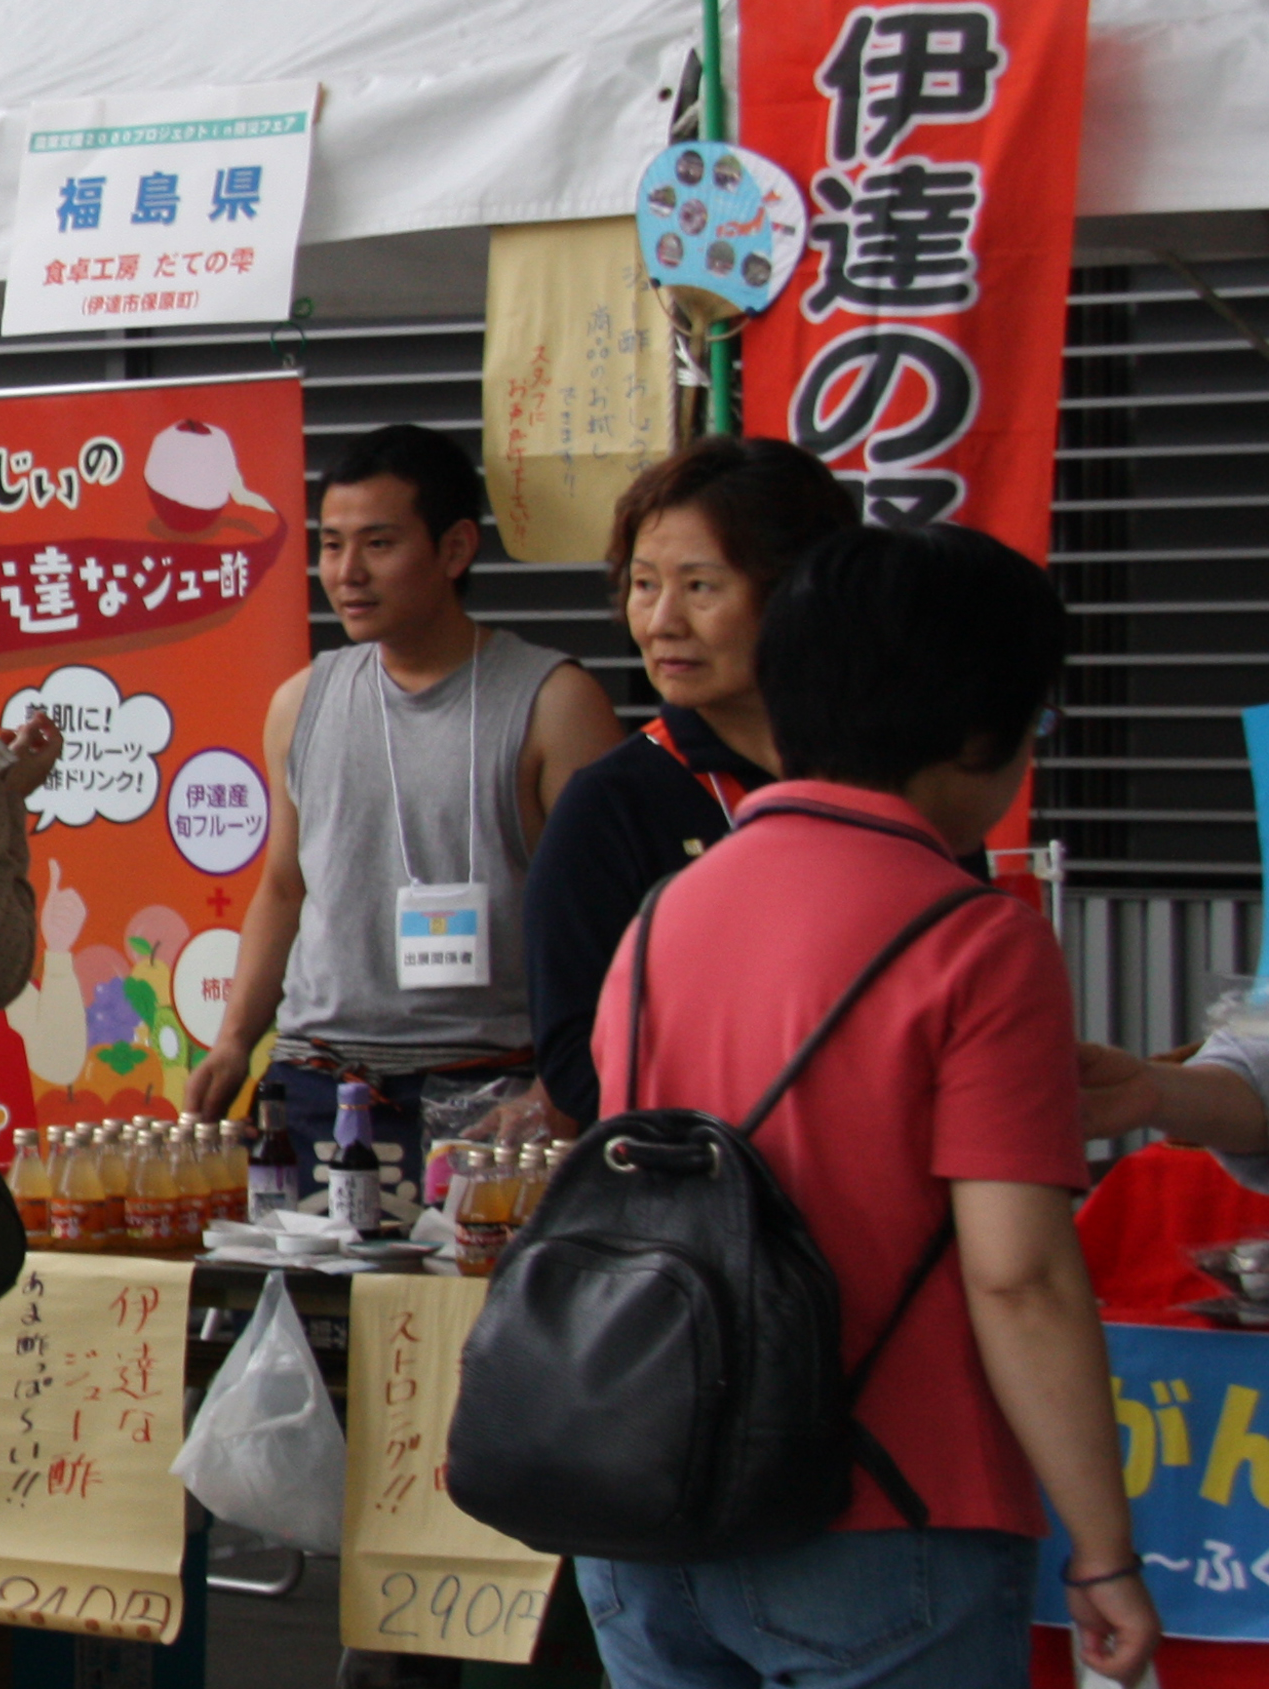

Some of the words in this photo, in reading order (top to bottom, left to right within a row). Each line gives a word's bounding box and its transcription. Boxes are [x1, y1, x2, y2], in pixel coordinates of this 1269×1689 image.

[55, 165, 264, 233] 福島県
[43, 253, 141, 286] 食卓工房
[152, 247, 255, 278] だての雫
[185, 783, 248, 809] 伊達産
[176, 815, 263, 838] 旬フルーツ
[105, 1285, 162, 1445] 伊達な
[377, 1571, 548, 1642] 290円
